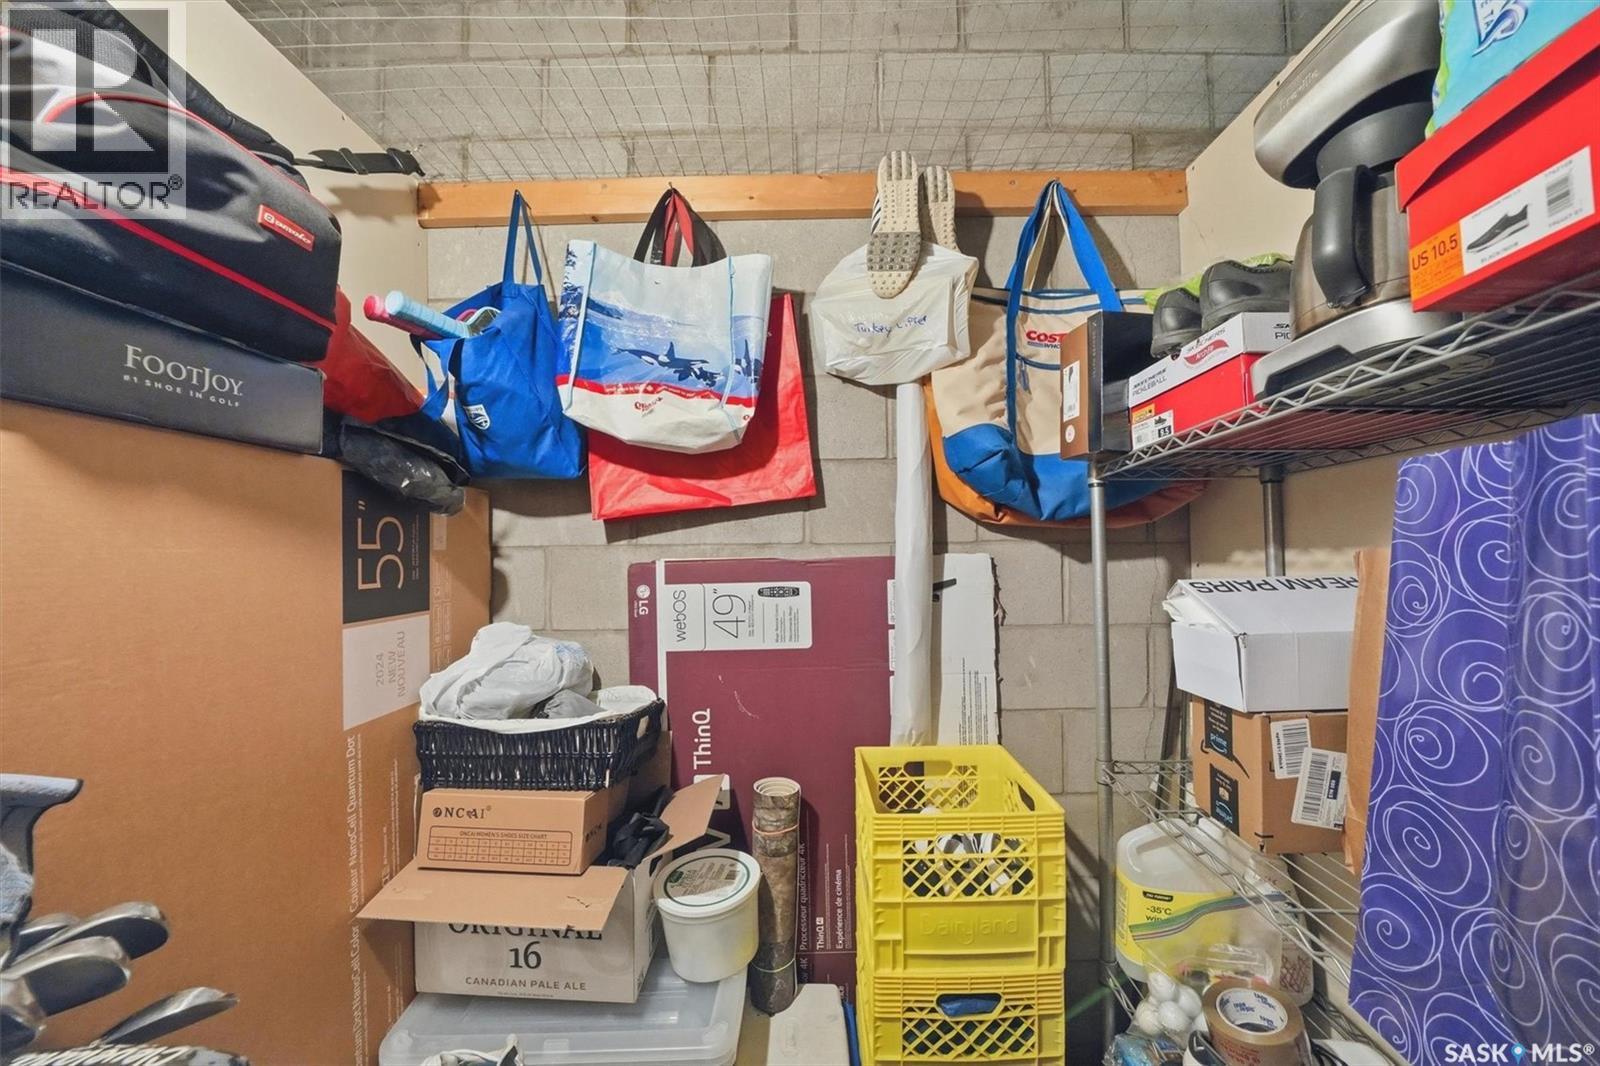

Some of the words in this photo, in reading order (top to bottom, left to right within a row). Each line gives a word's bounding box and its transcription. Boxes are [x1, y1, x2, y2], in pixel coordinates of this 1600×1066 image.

[1411, 252, 1429, 270] US
[1431, 233, 1458, 260] 10.5
[1025, 330, 1068, 343] COST
[145, 379, 182, 394] SHOE
[189, 389, 203, 400] IN
[209, 395, 240, 408] GOLF
[1188, 579, 1279, 594] PAIRS
[1276, 576, 1359, 590] REAM
[638, 599, 649, 616] LG
[673, 589, 687, 643] webOS
[376, 652, 385, 687] 2024
[388, 650, 397, 684] NEW
[397, 630, 406, 698] NOUVEAU
[346, 734, 356, 757] Dot
[692, 707, 712, 770] ThinQ
[346, 759, 357, 812] Quantum
[347, 813, 358, 866] NanoCell
[834, 869, 843, 896] cinéma
[835, 898, 843, 907] de
[349, 925, 360, 956] Color
[816, 925, 825, 950] ThinQ
[835, 908, 845, 949] Expérience
[920, 911, 1020, 945] Dairyland
[508, 940, 542, 969] 16
[465, 976, 527, 988] CANADIAN
[530, 979, 560, 990] PALE
[563, 981, 586, 991] ALE
